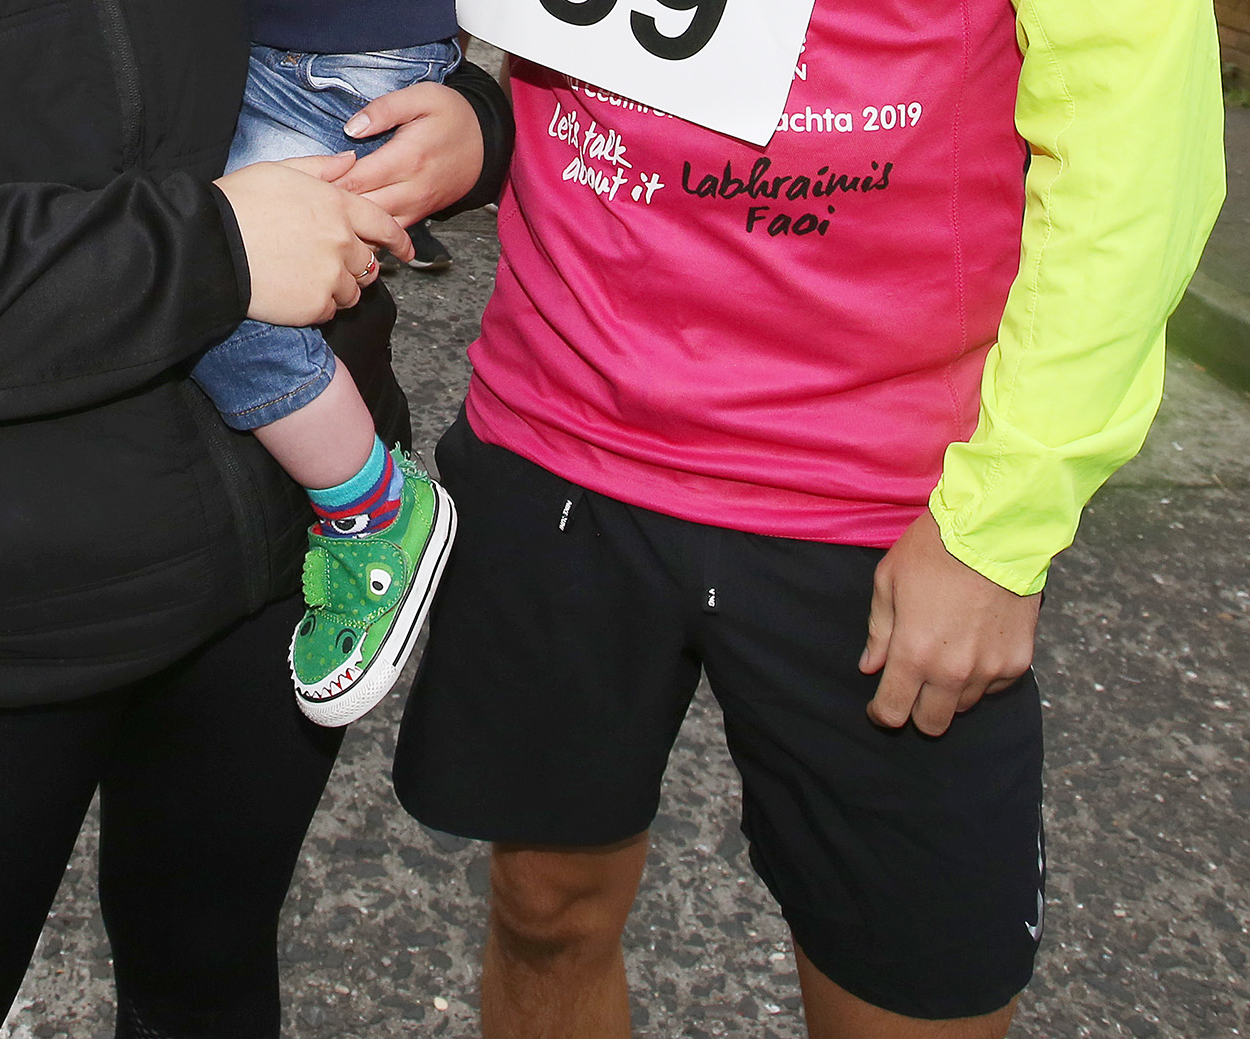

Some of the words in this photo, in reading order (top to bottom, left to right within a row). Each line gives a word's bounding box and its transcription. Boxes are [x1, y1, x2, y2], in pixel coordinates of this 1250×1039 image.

[548, 102, 580, 148] Let's
[583, 121, 633, 168] talk
[862, 102, 923, 132] 2019
[562, 146, 629, 201] about
[631, 172, 665, 204] it
[747, 205, 835, 237] Faoi
